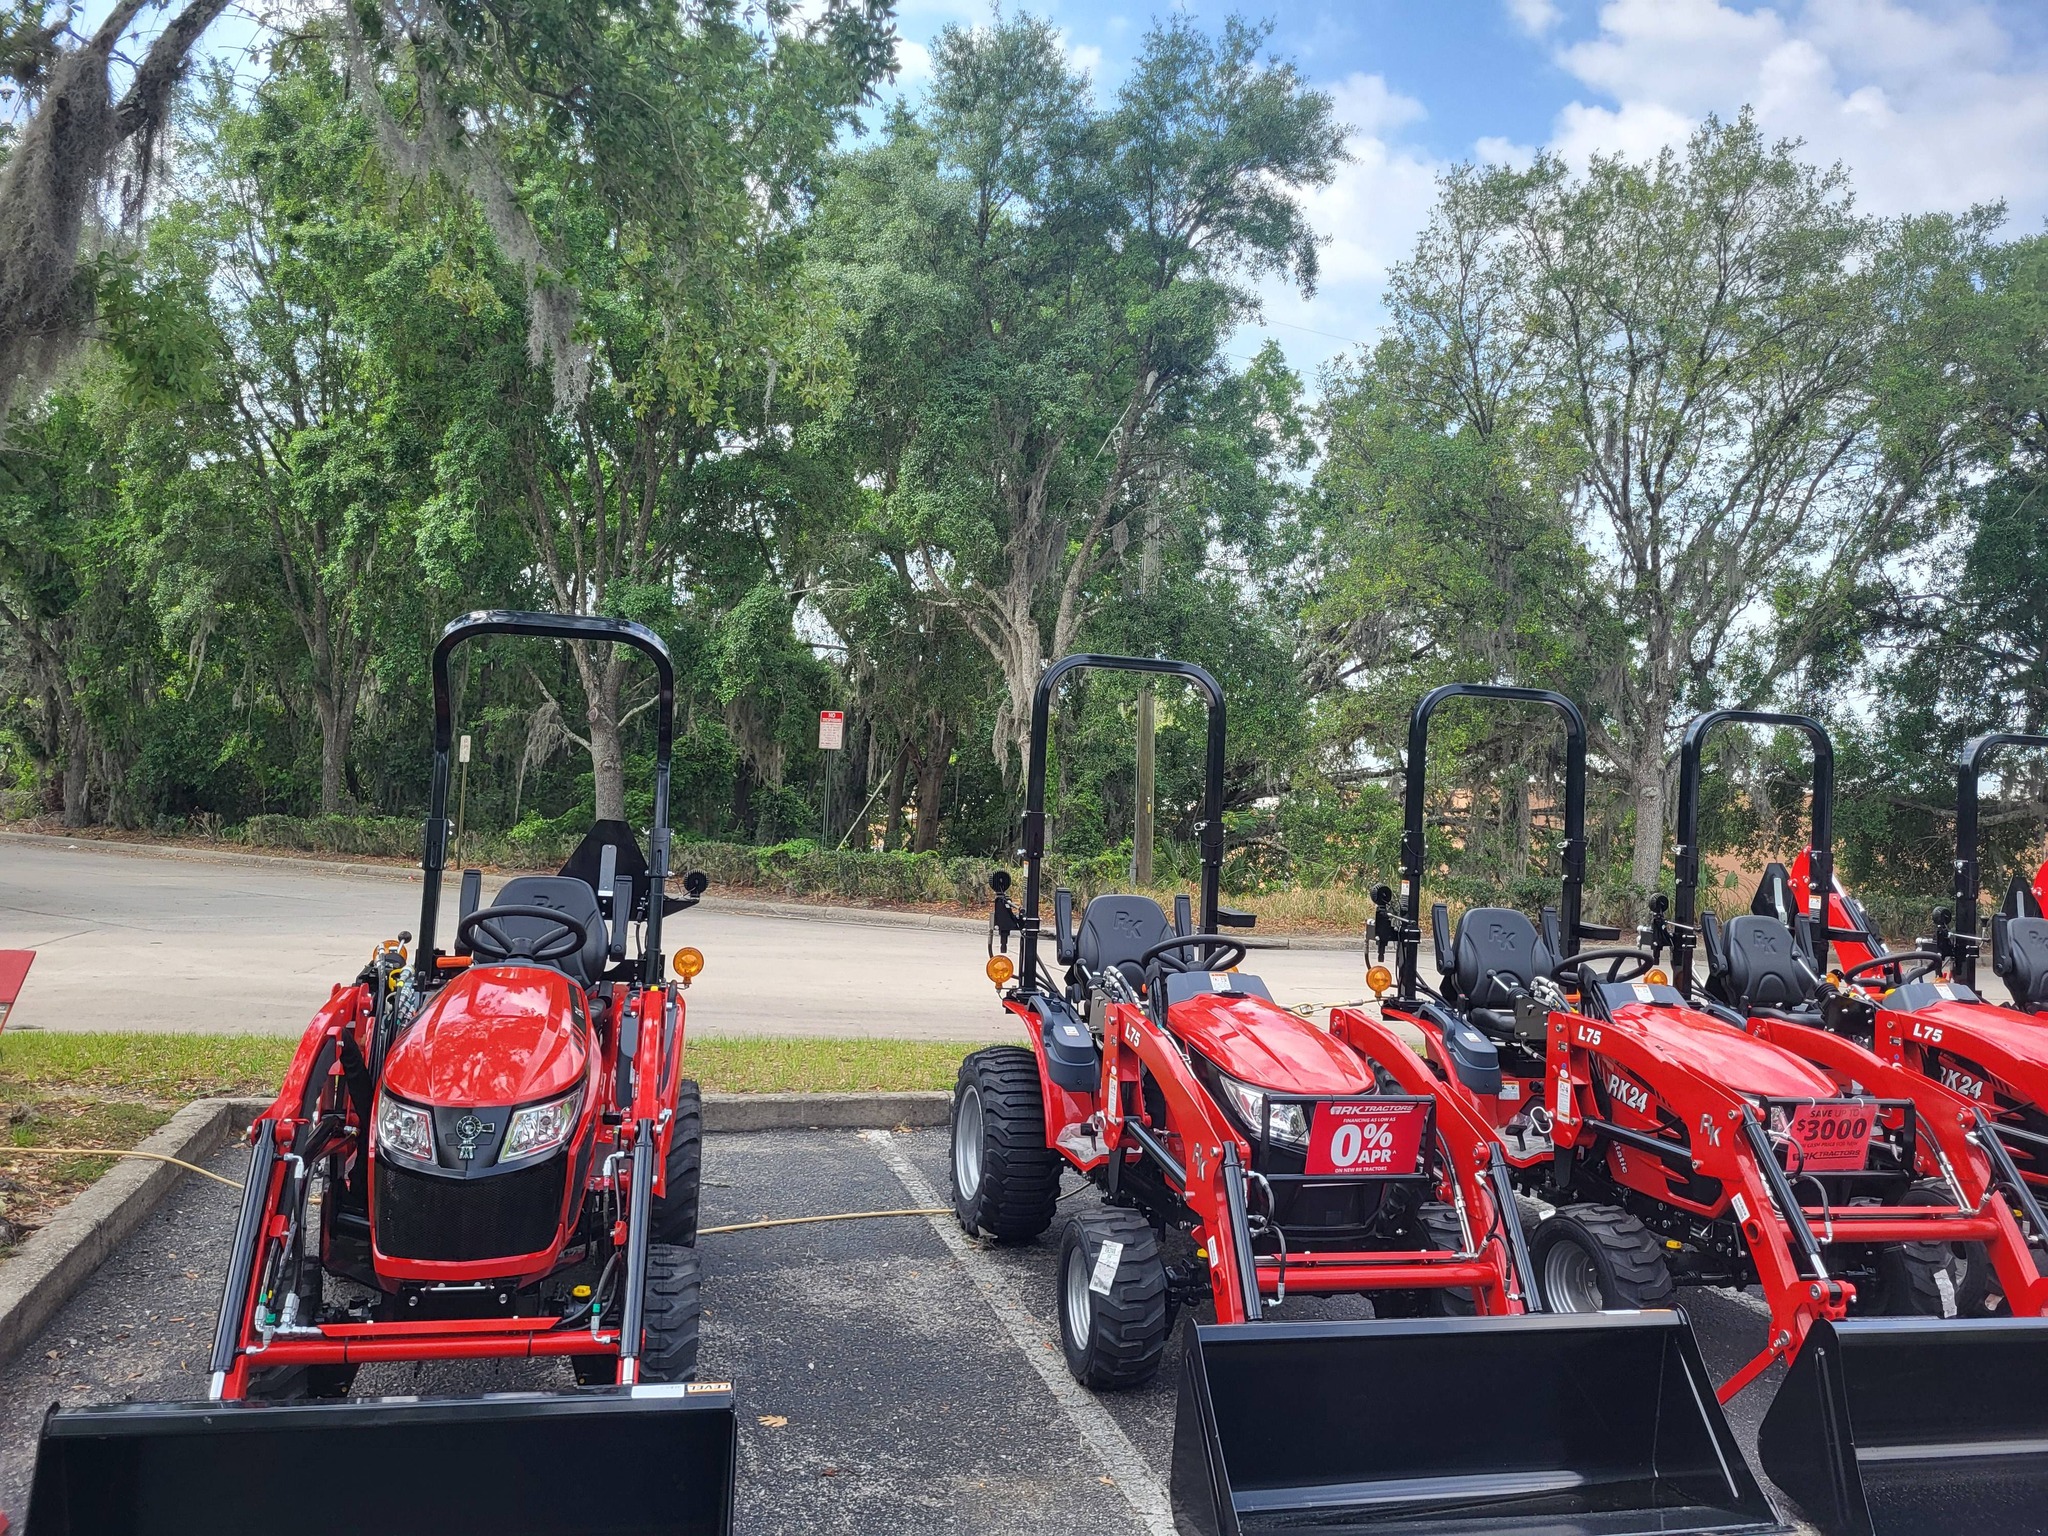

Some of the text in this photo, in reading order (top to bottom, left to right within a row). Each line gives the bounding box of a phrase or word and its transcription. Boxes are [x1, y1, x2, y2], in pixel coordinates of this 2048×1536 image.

[1113, 910, 1143, 939] RK
[1488, 923, 1517, 951] RK
[1752, 929, 1777, 954] RK
[1125, 1023, 1141, 1048] L75
[1578, 1025, 1601, 1046] L75
[1912, 1023, 1943, 1043] L75
[1608, 1073, 1649, 1113] RK24
[1810, 1108, 1860, 1118] SAVE UP TO
[1699, 1113, 1723, 1147] RK
[1796, 1118, 1867, 1141] $3000
[1331, 1123, 1393, 1167] 0%
